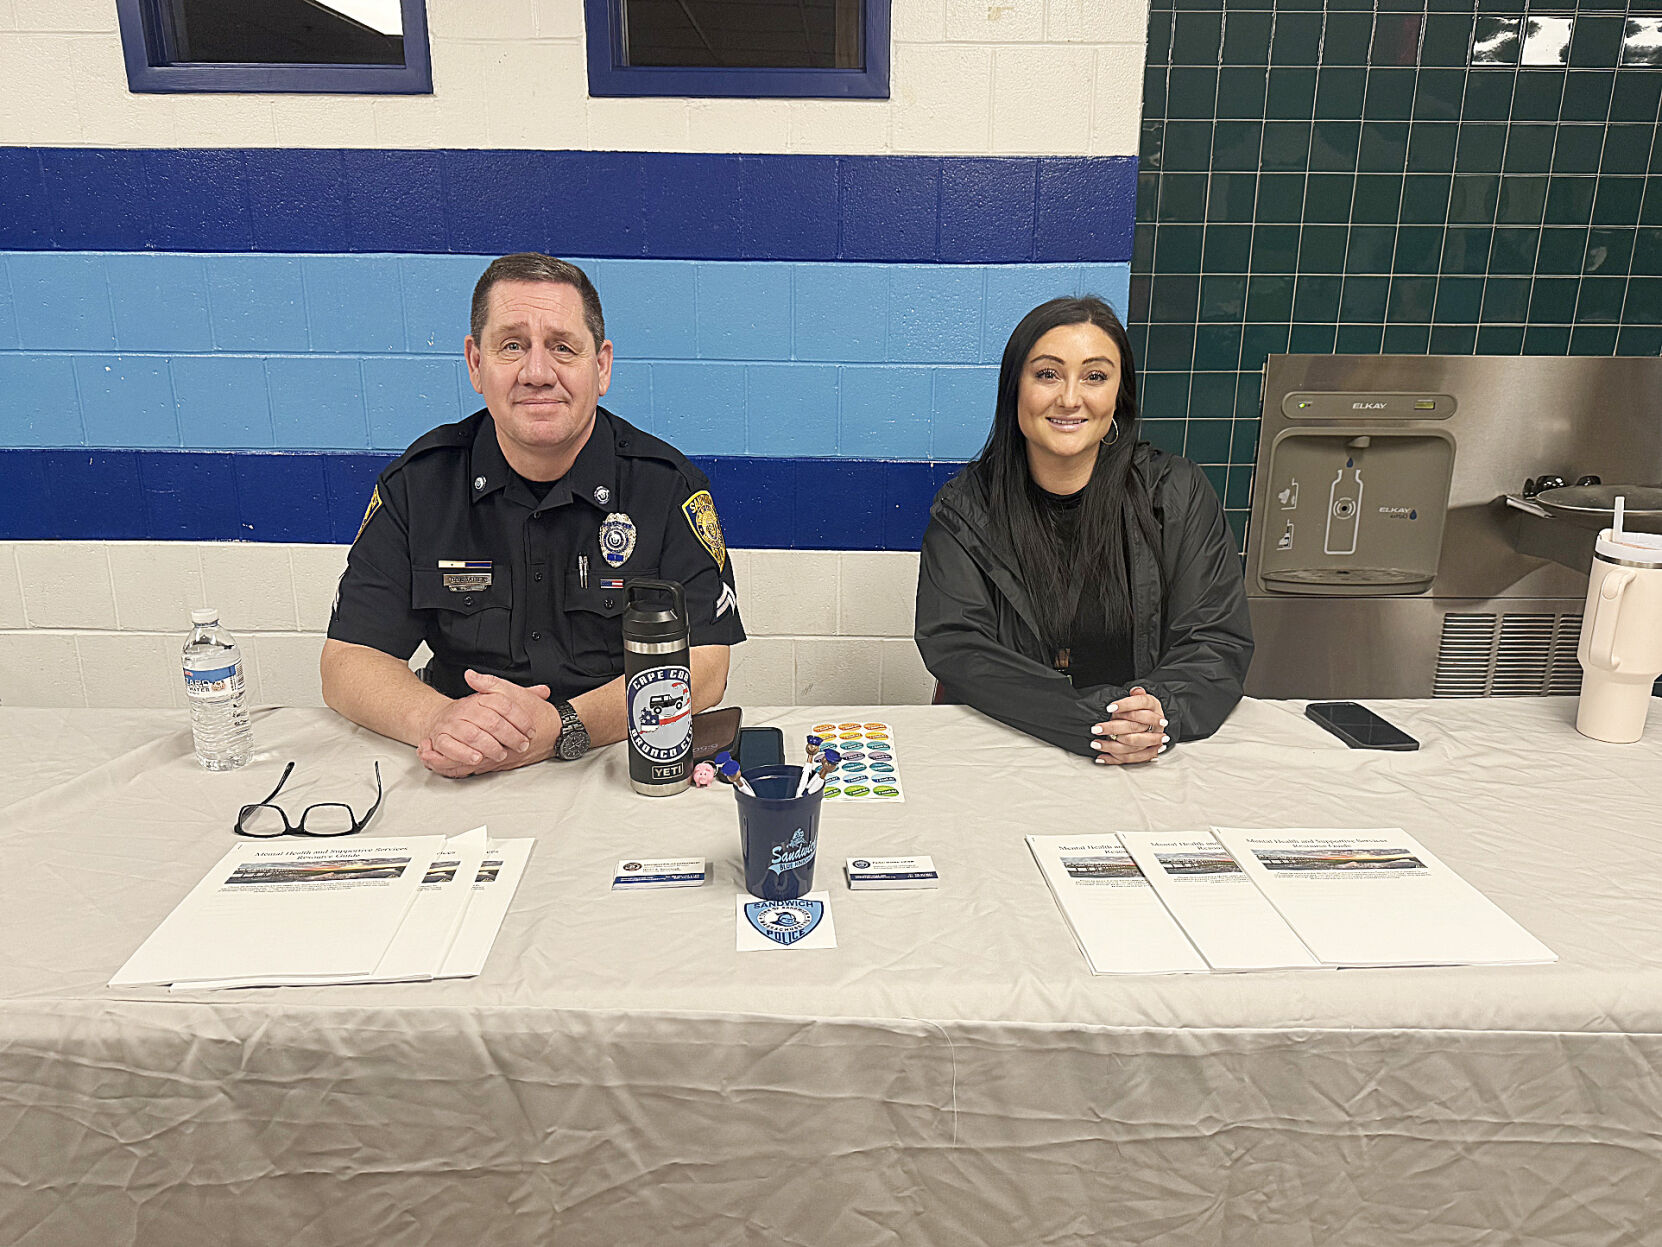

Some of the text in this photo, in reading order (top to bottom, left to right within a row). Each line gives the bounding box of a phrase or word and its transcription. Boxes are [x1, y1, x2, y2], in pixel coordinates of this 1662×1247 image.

[632, 669, 690, 690] CAPE COD
[630, 728, 678, 758] BRONCO
[653, 765, 682, 777] YETI
[753, 900, 814, 909] SANDWICH
[766, 928, 806, 944] POLICE
